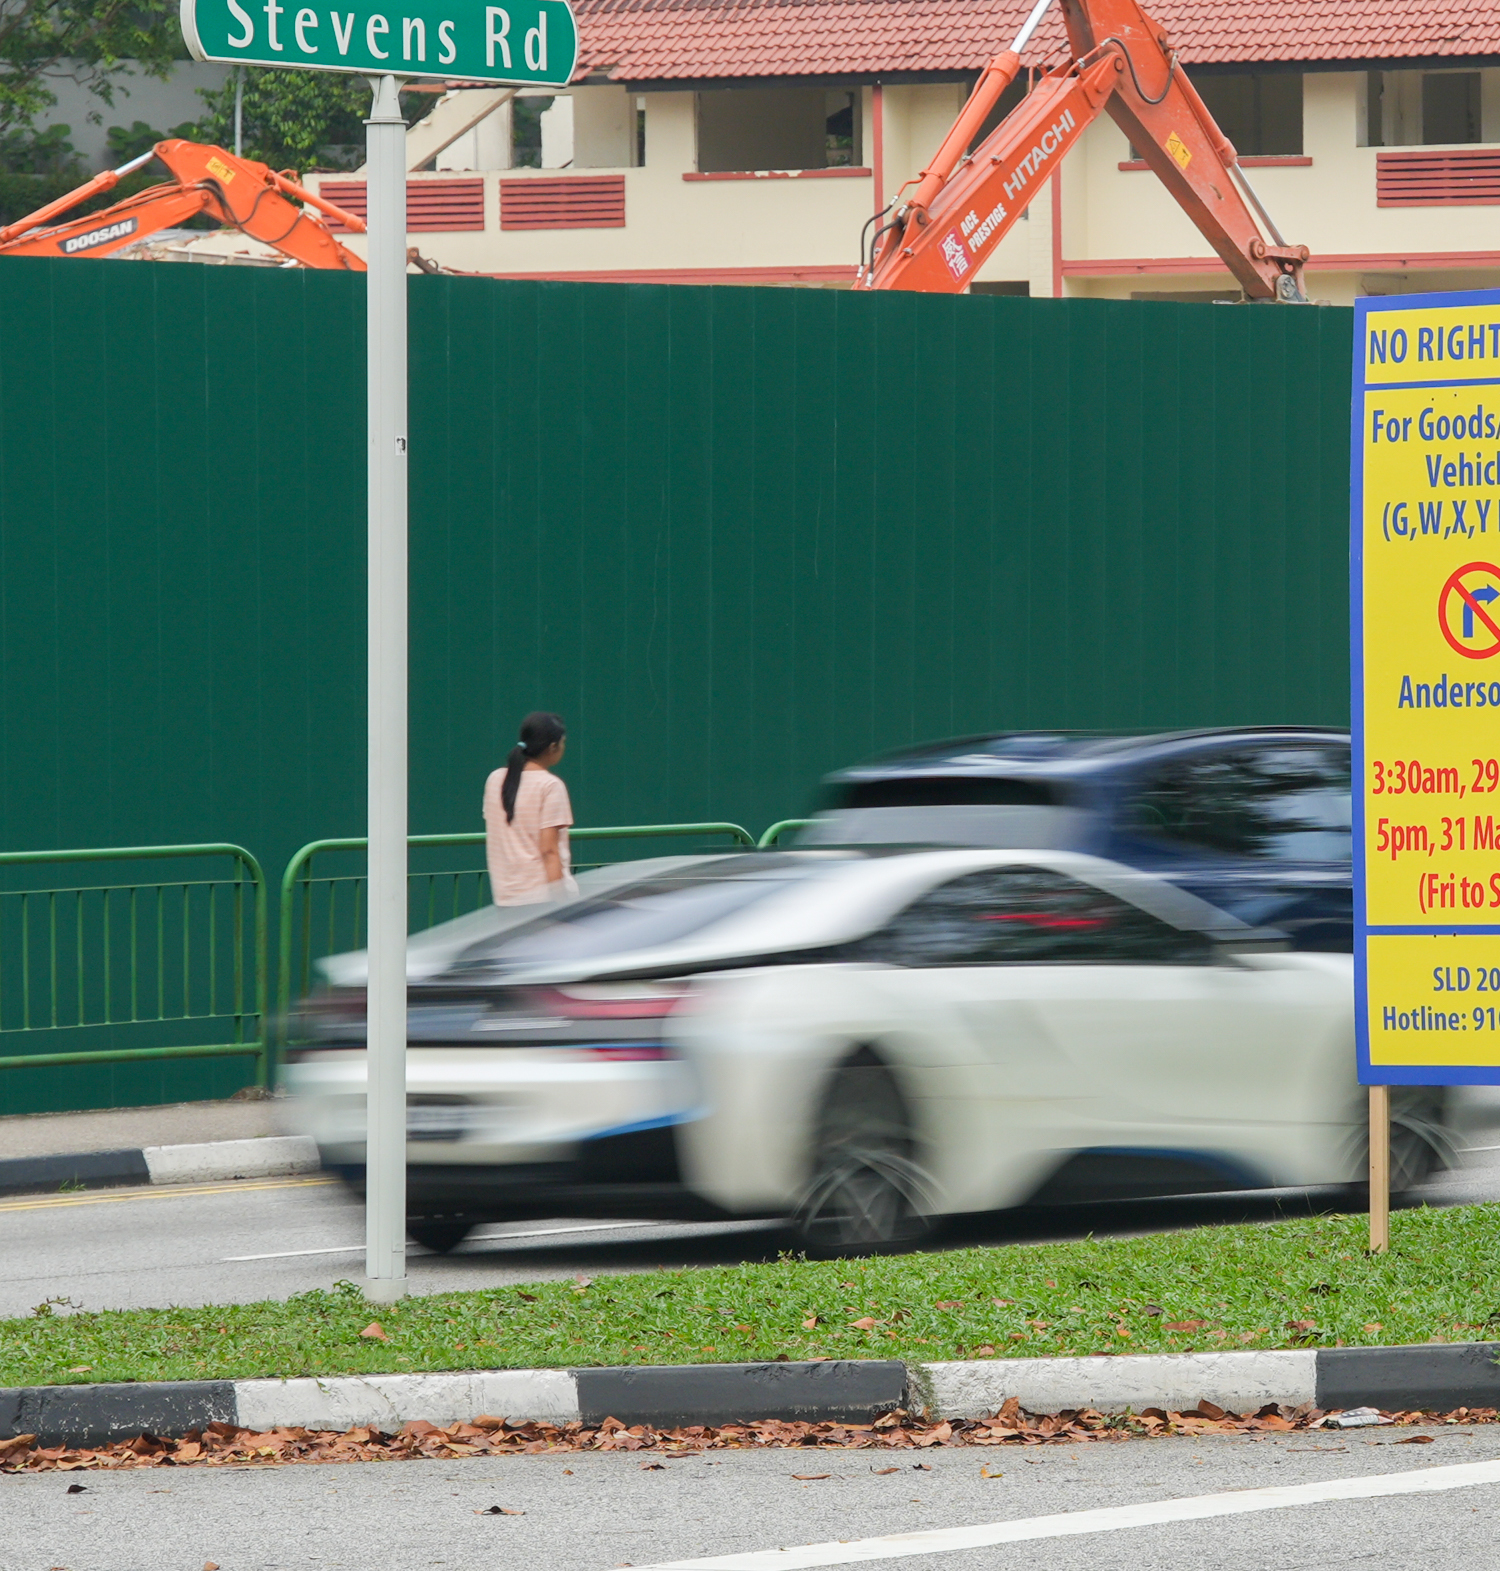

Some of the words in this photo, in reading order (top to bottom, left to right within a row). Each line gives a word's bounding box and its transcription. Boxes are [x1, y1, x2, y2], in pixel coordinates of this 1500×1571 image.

[228, 0, 456, 64] Stevens
[485, 6, 547, 71] Rd
[1003, 109, 1076, 200] HITACHI
[66, 219, 133, 253] DOOSAN
[960, 210, 979, 237] ACE
[968, 202, 1007, 253] PRESTIGE
[942, 233, 969, 278] 威信
[1369, 328, 1408, 364] NO
[1372, 409, 1413, 443] For
[1382, 501, 1493, 542] (G,W,X,Y
[1372, 759, 1467, 800] 3:30am,
[1470, 758, 1500, 793] 29
[1376, 817, 1436, 861] 5pm,
[1439, 816, 1467, 851] 31
[1418, 872, 1456, 914] (Fri
[1460, 876, 1485, 909] to
[1432, 966, 1471, 992] SLD
[1382, 1005, 1467, 1031] Hotline:
